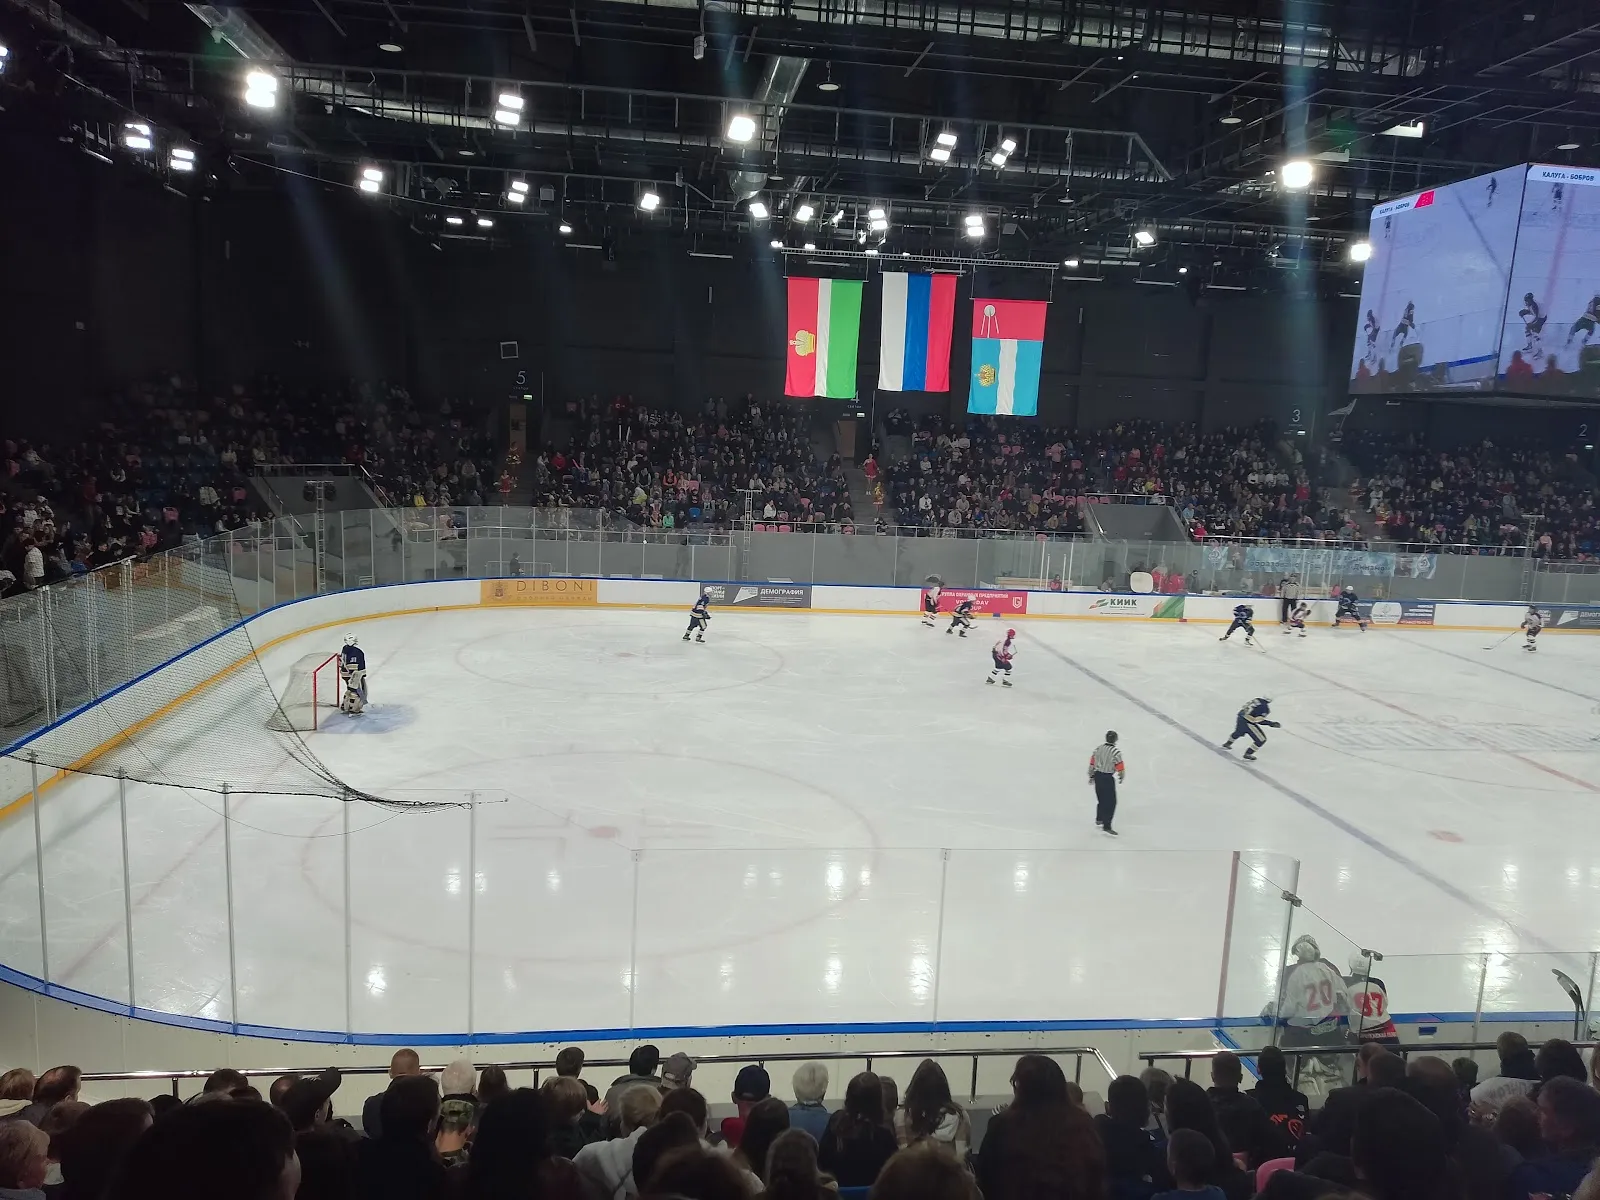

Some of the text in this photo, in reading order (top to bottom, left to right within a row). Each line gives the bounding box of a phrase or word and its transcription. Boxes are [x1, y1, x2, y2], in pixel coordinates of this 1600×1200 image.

[1542, 171, 1565, 179] КАЛУГА
[516, 370, 526, 385] 5
[850, 390, 860, 404] 4
[1292, 409, 1301, 422] 3
[1579, 423, 1588, 437] 2
[516, 580, 592, 592] DIBONI
[760, 588, 804, 596] ДЕМОГРАФИЯ
[1110, 598, 1137, 606] КИИК
[1304, 979, 1334, 1013] 20
